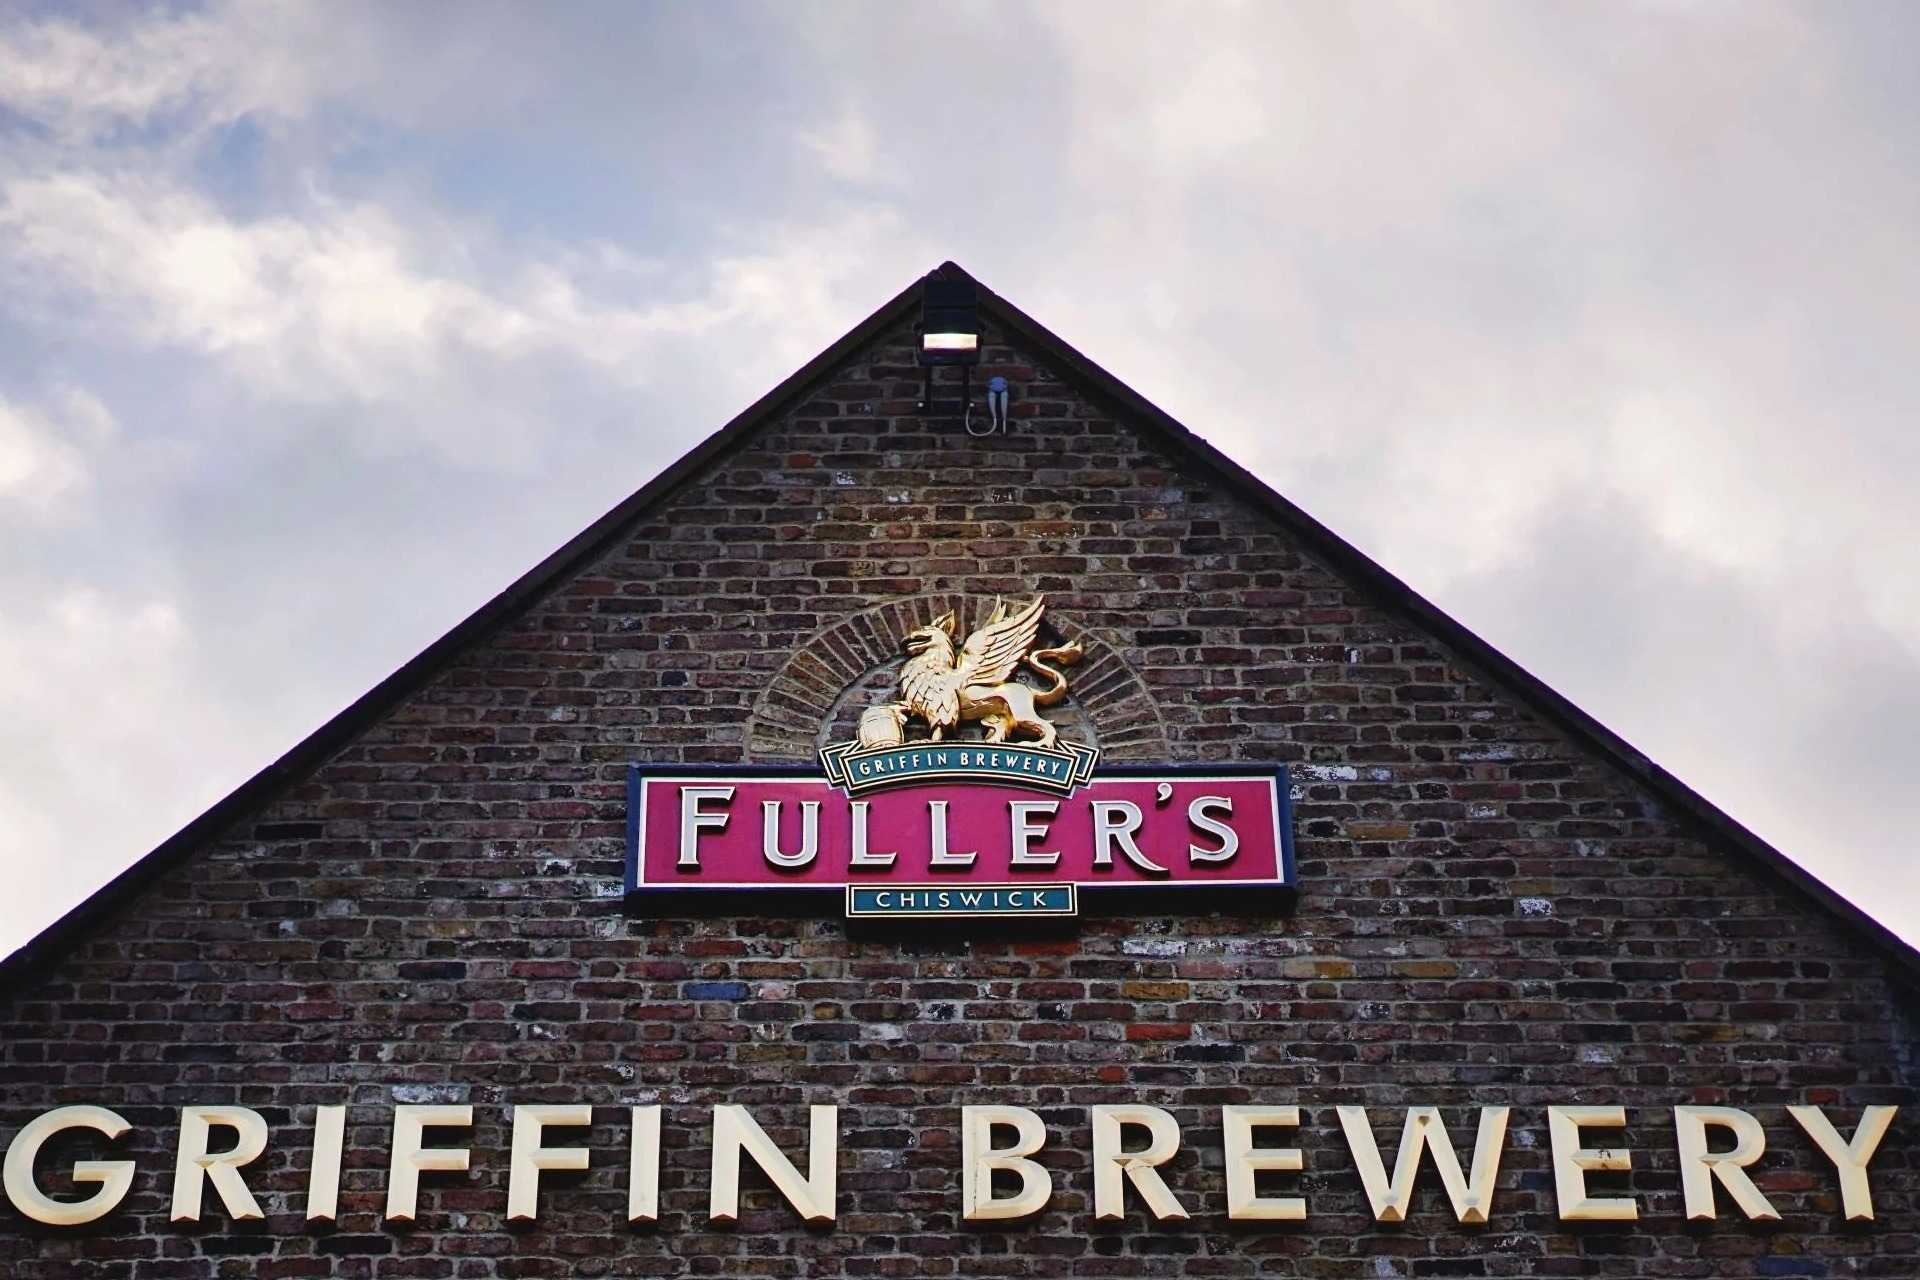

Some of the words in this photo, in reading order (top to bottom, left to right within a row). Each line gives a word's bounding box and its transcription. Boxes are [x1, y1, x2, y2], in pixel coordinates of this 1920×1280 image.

[859, 752, 948, 775] GRIFFIN
[960, 753, 1061, 775] BREWERY
[876, 891, 1047, 907] CHISWICK
[3, 1104, 838, 1225] GRIFFIN
[962, 1104, 1900, 1223] BREWERY
